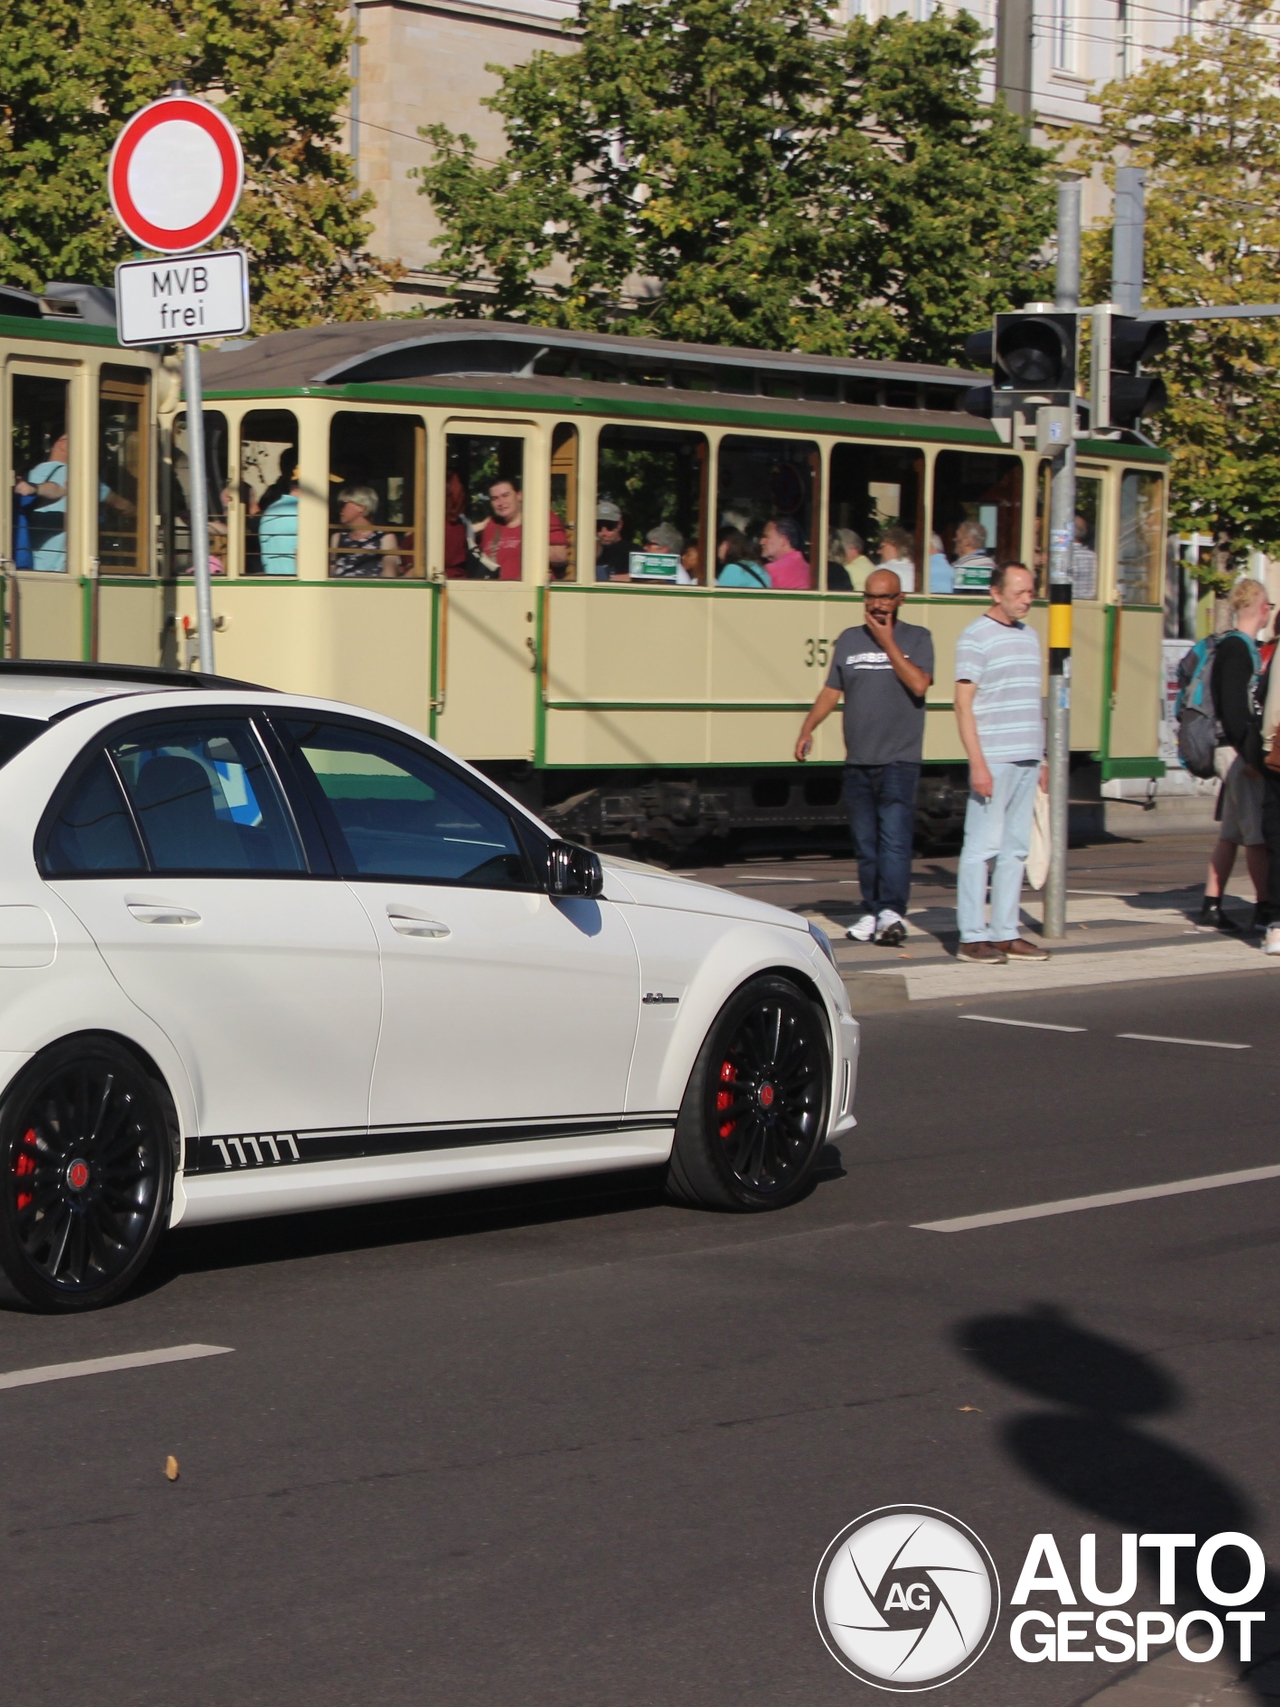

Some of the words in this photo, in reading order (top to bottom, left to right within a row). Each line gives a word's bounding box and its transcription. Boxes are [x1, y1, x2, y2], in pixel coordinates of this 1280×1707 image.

[152, 266, 208, 297] MVB
[160, 300, 204, 329] frei
[804, 638, 837, 668] 35
